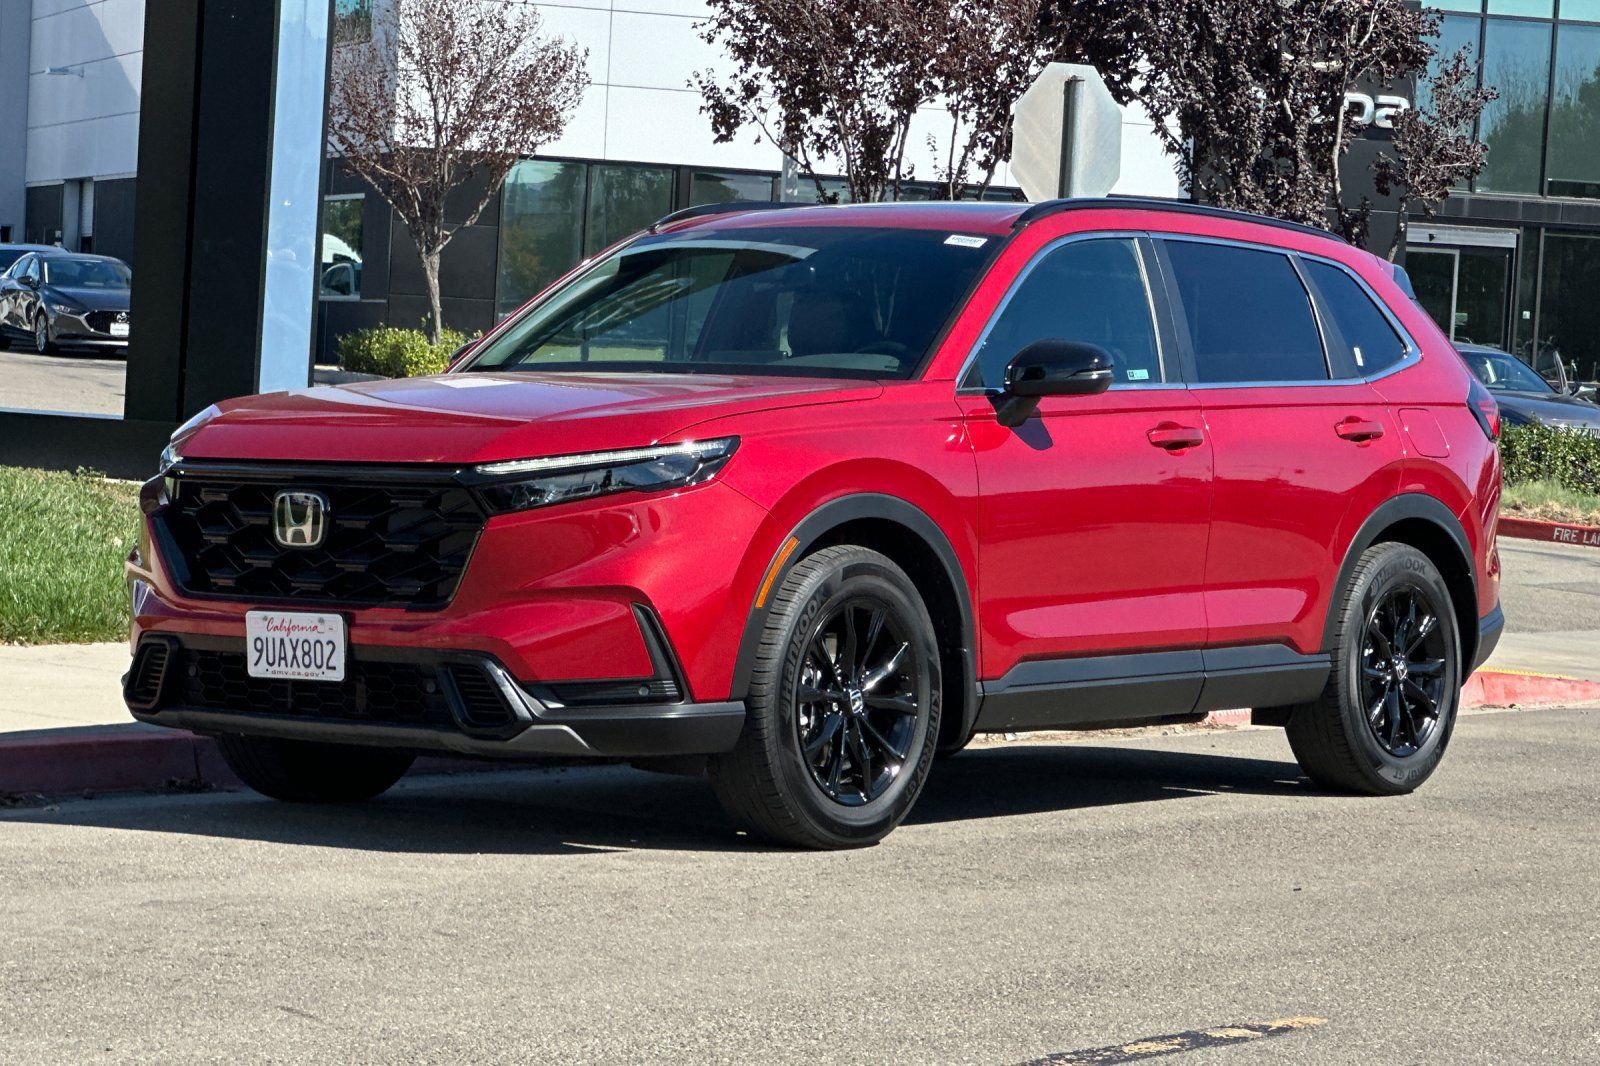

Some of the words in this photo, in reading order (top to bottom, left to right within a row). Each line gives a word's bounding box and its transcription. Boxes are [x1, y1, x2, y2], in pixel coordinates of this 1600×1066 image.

[1553, 527, 1579, 542] FIRE
[266, 617, 319, 637] California
[253, 637, 337, 671] 9UAX802
[271, 670, 320, 678] dmv.ca.gov
